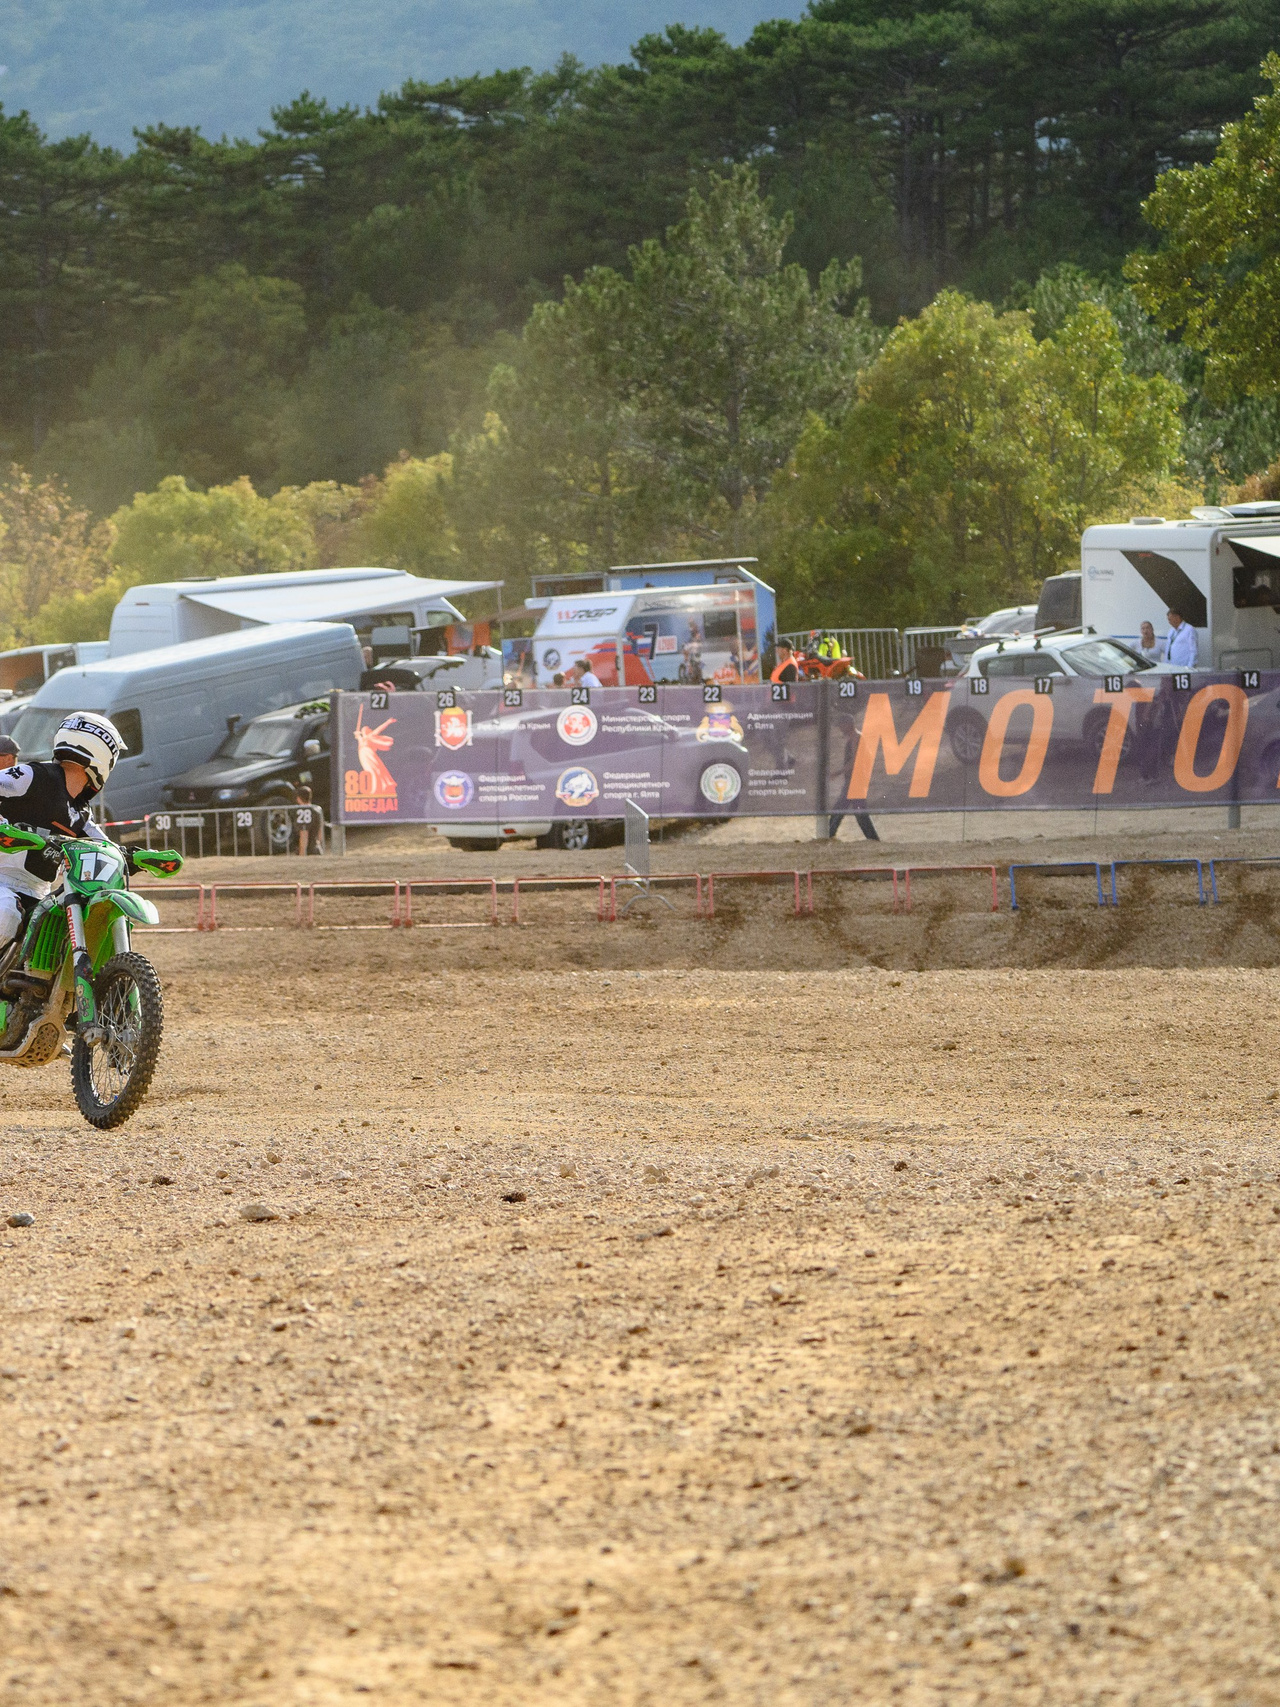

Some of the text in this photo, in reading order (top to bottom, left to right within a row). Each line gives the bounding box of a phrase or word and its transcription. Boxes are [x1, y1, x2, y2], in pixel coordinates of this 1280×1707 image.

[907, 680, 922, 695] 19
[973, 679, 987, 693] 18
[1037, 678, 1052, 692] 17
[1106, 676, 1121, 691] 16
[1174, 675, 1189, 689] 15
[1244, 673, 1259, 688] 14
[572, 689, 589, 703] 24
[639, 688, 655, 702] 23
[704, 687, 720, 701] 22
[773, 686, 788, 700] 21
[840, 682, 855, 697] 20
[371, 694, 387, 708] 27
[438, 692, 454, 707] 26
[505, 691, 521, 705] 25
[601, 714, 663, 723] Министерс
[747, 712, 814, 721] Администрация
[527, 722, 551, 732] Крым
[601, 724, 652, 733] Республики
[754, 722, 775, 730] Ялта
[847, 684, 1280, 800] МОТО
[478, 774, 526, 783] Федерация
[603, 771, 651, 781] Федерация
[748, 768, 795, 778] Федерация
[344, 770, 373, 795] 80
[478, 785, 546, 793] мотоциклетного
[603, 781, 671, 790] мотоциклетного
[478, 794, 540, 803] спорта России
[603, 791, 632, 800] спорта
[640, 790, 660, 799] Ялта
[748, 788, 807, 797] спорта Крыма
[344, 798, 399, 814] ПОБЕДА!
[155, 815, 170, 831] 30
[237, 812, 253, 827] 29
[297, 808, 312, 824] 28
[78, 852, 120, 883] 17
